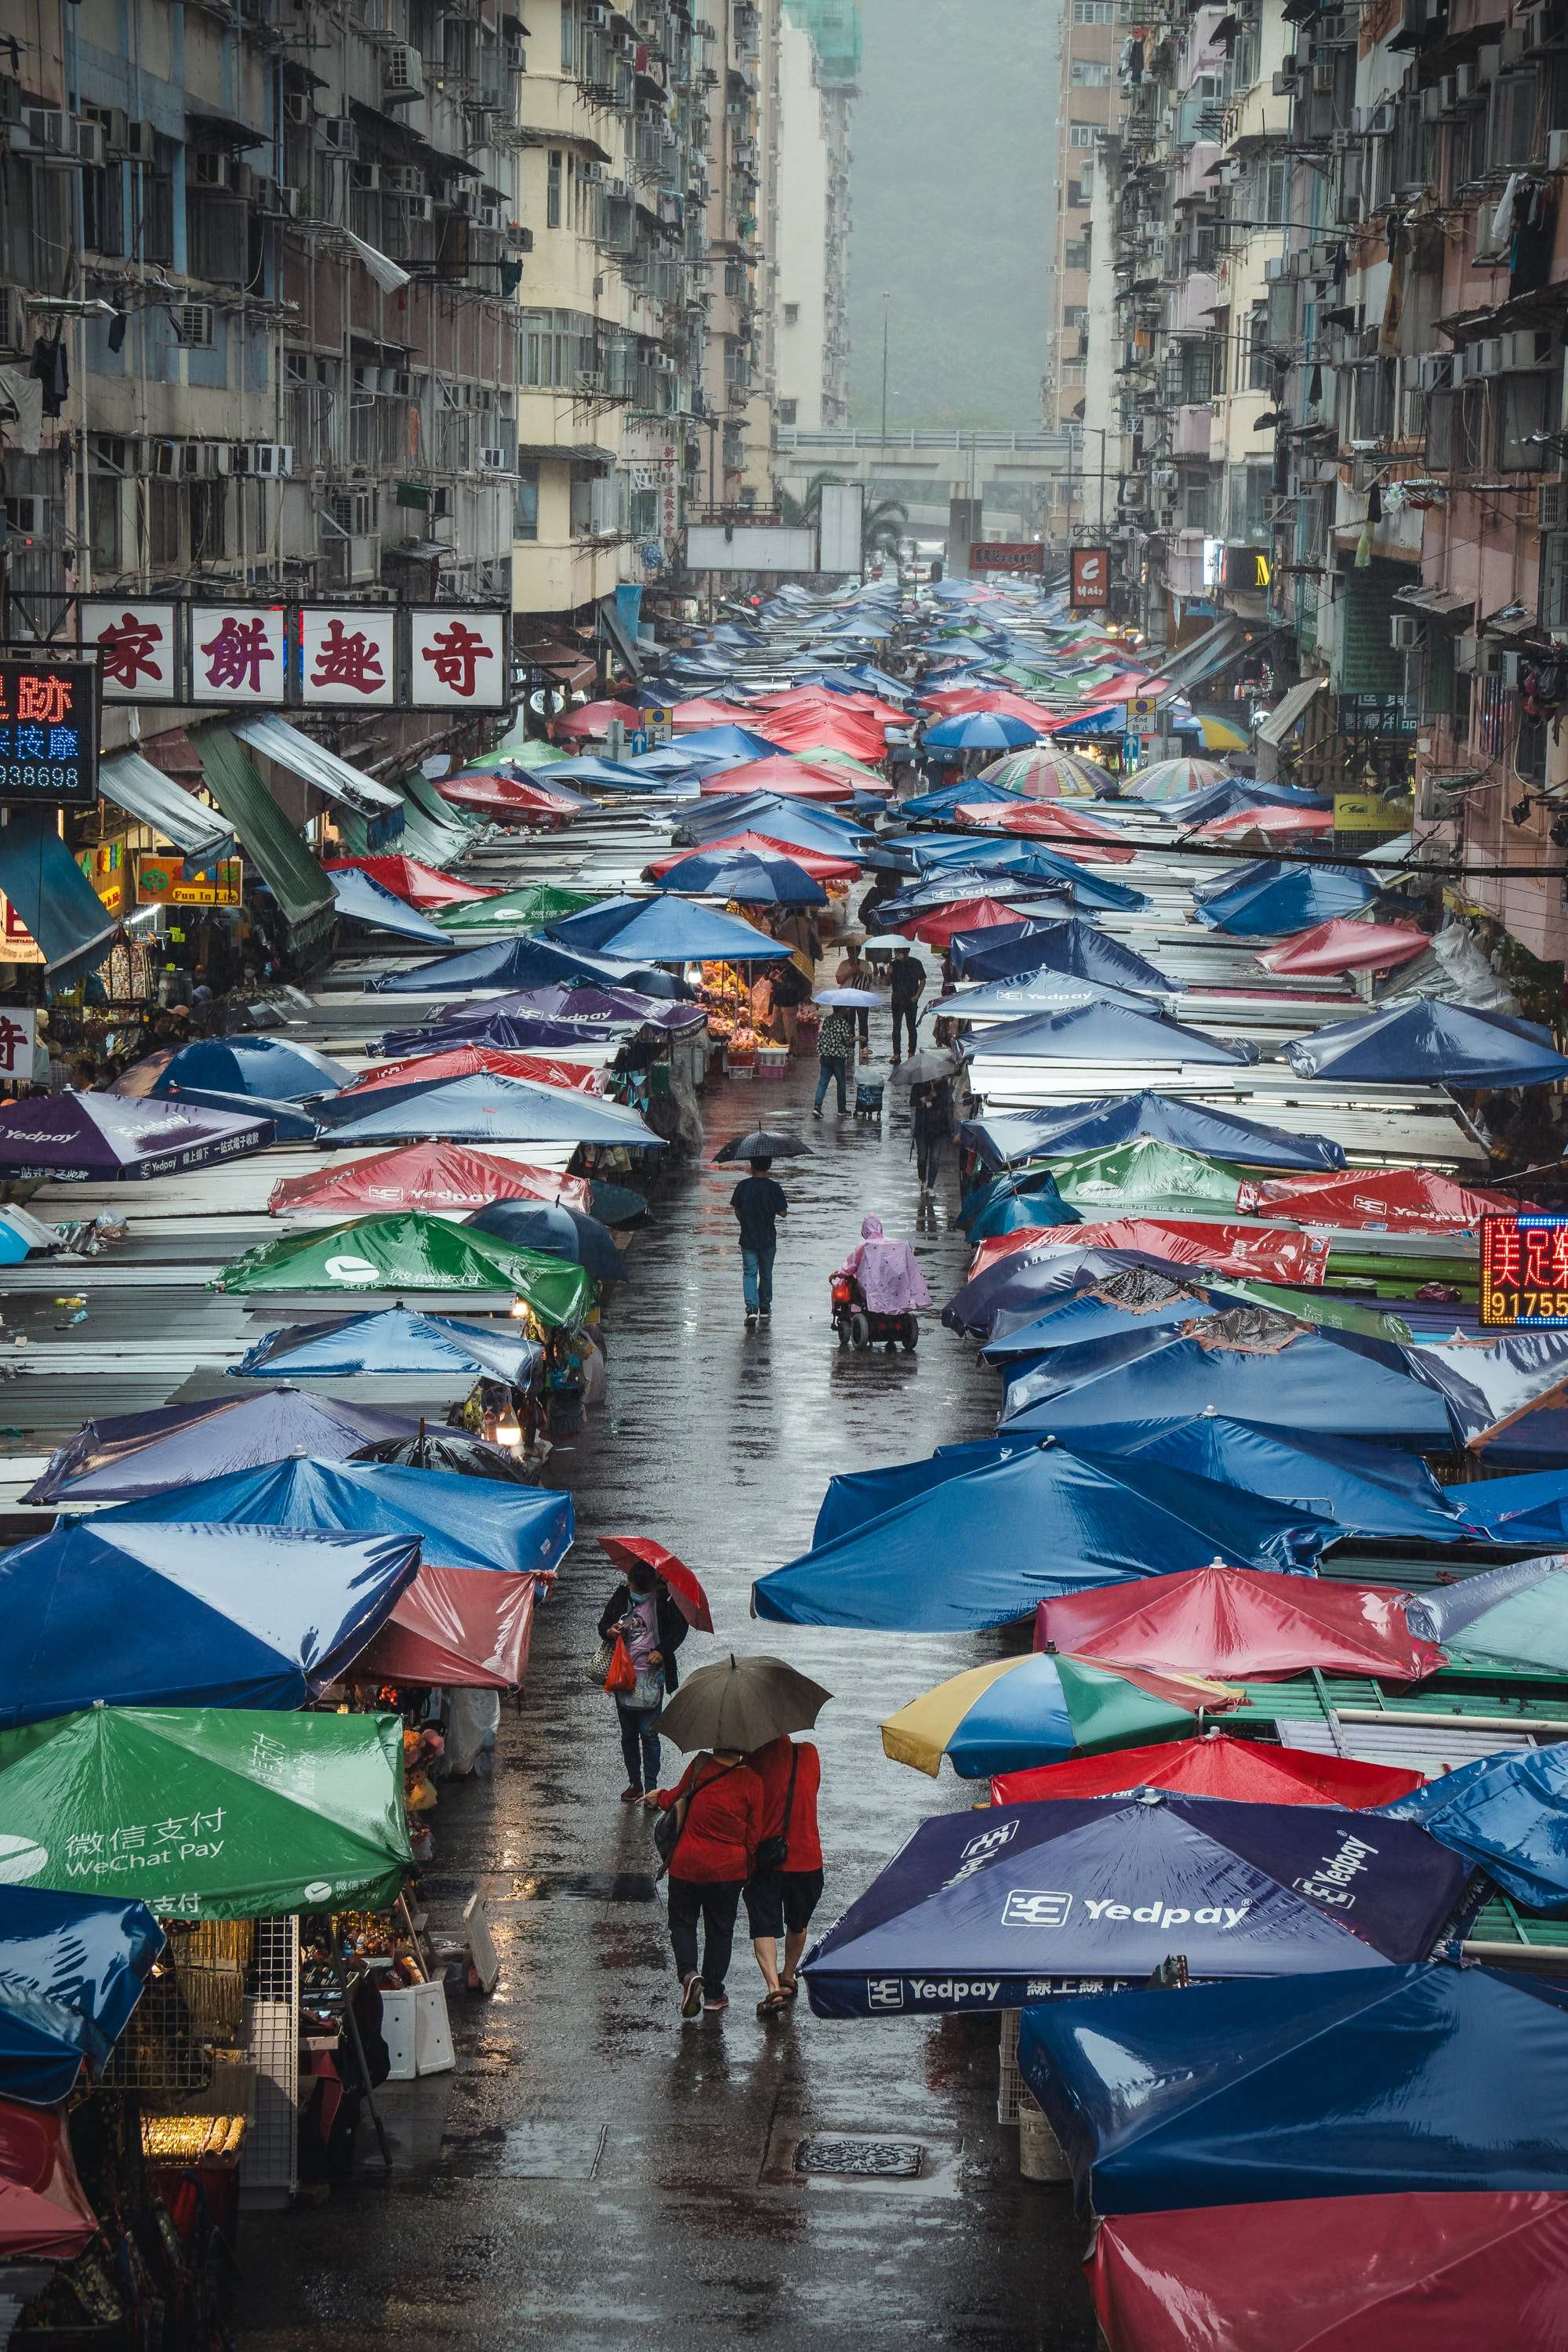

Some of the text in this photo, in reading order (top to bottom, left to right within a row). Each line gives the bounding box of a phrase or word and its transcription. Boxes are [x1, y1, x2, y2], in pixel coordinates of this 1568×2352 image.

[0, 675, 73, 722] 跡
[175, 890, 196, 901] Fun
[199, 891, 212, 901] In
[956, 883, 1014, 897] Yedpay
[1026, 991, 1093, 1001] Yedpay
[549, 1008, 614, 1021] Yedpay
[5, 1129, 78, 1144] Yedpay
[151, 1158, 177, 1172] Yedpay
[410, 1189, 498, 1204] Yedpay
[1392, 1206, 1480, 1228] Yedpay
[64, 1806, 227, 1859] 微信支付
[65, 1840, 225, 1878] WeChat Pay
[1312, 1835, 1380, 1887] Yedpay
[1083, 1899, 1250, 1929] Yedpay
[909, 1979, 1001, 2002] Yedpay
